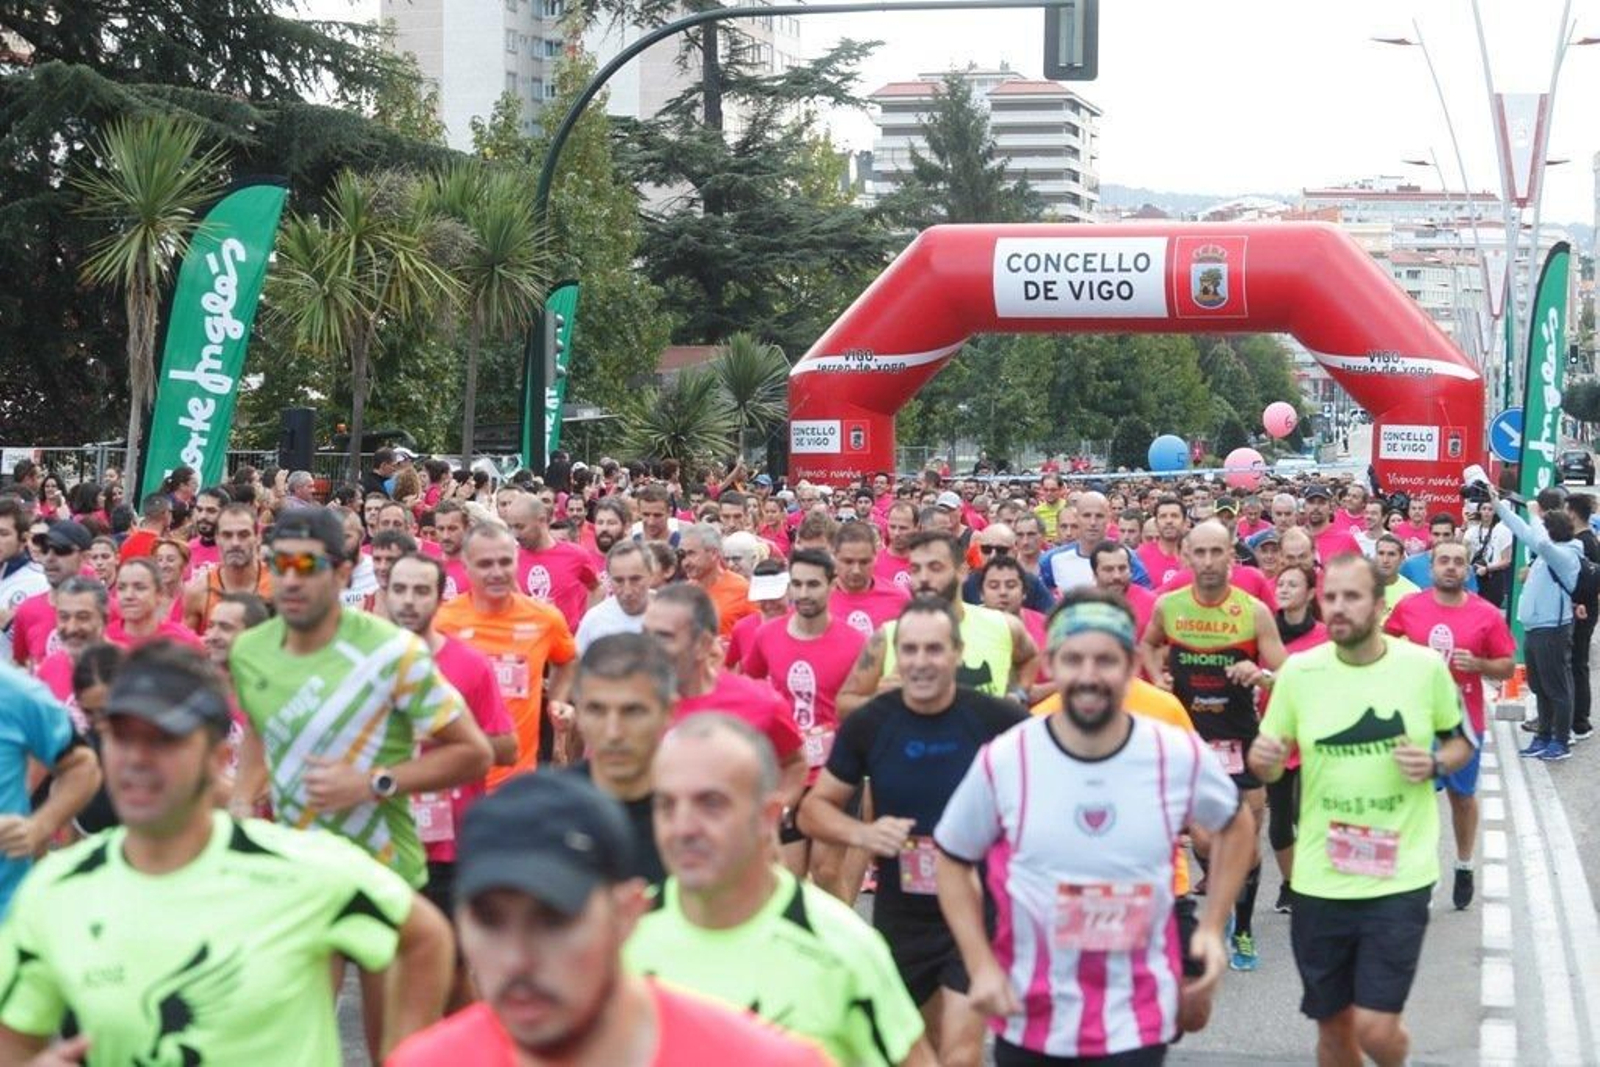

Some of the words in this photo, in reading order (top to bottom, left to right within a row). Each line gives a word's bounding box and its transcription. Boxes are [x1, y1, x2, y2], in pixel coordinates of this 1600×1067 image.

[1006, 252, 1151, 273] CONCELLO
[1023, 280, 1059, 301] DE
[1068, 280, 1134, 301] VIGO
[1284, 415, 1292, 429] 6
[793, 426, 836, 436] CONCELLO
[1383, 431, 1434, 442] CONCELLO
[164, 397, 216, 497] orte
[795, 437, 804, 446] DE
[806, 437, 829, 446] VIGO
[1386, 443, 1398, 452] DE
[1401, 443, 1427, 453] VIGO
[1175, 620, 1240, 635] DISGALPA
